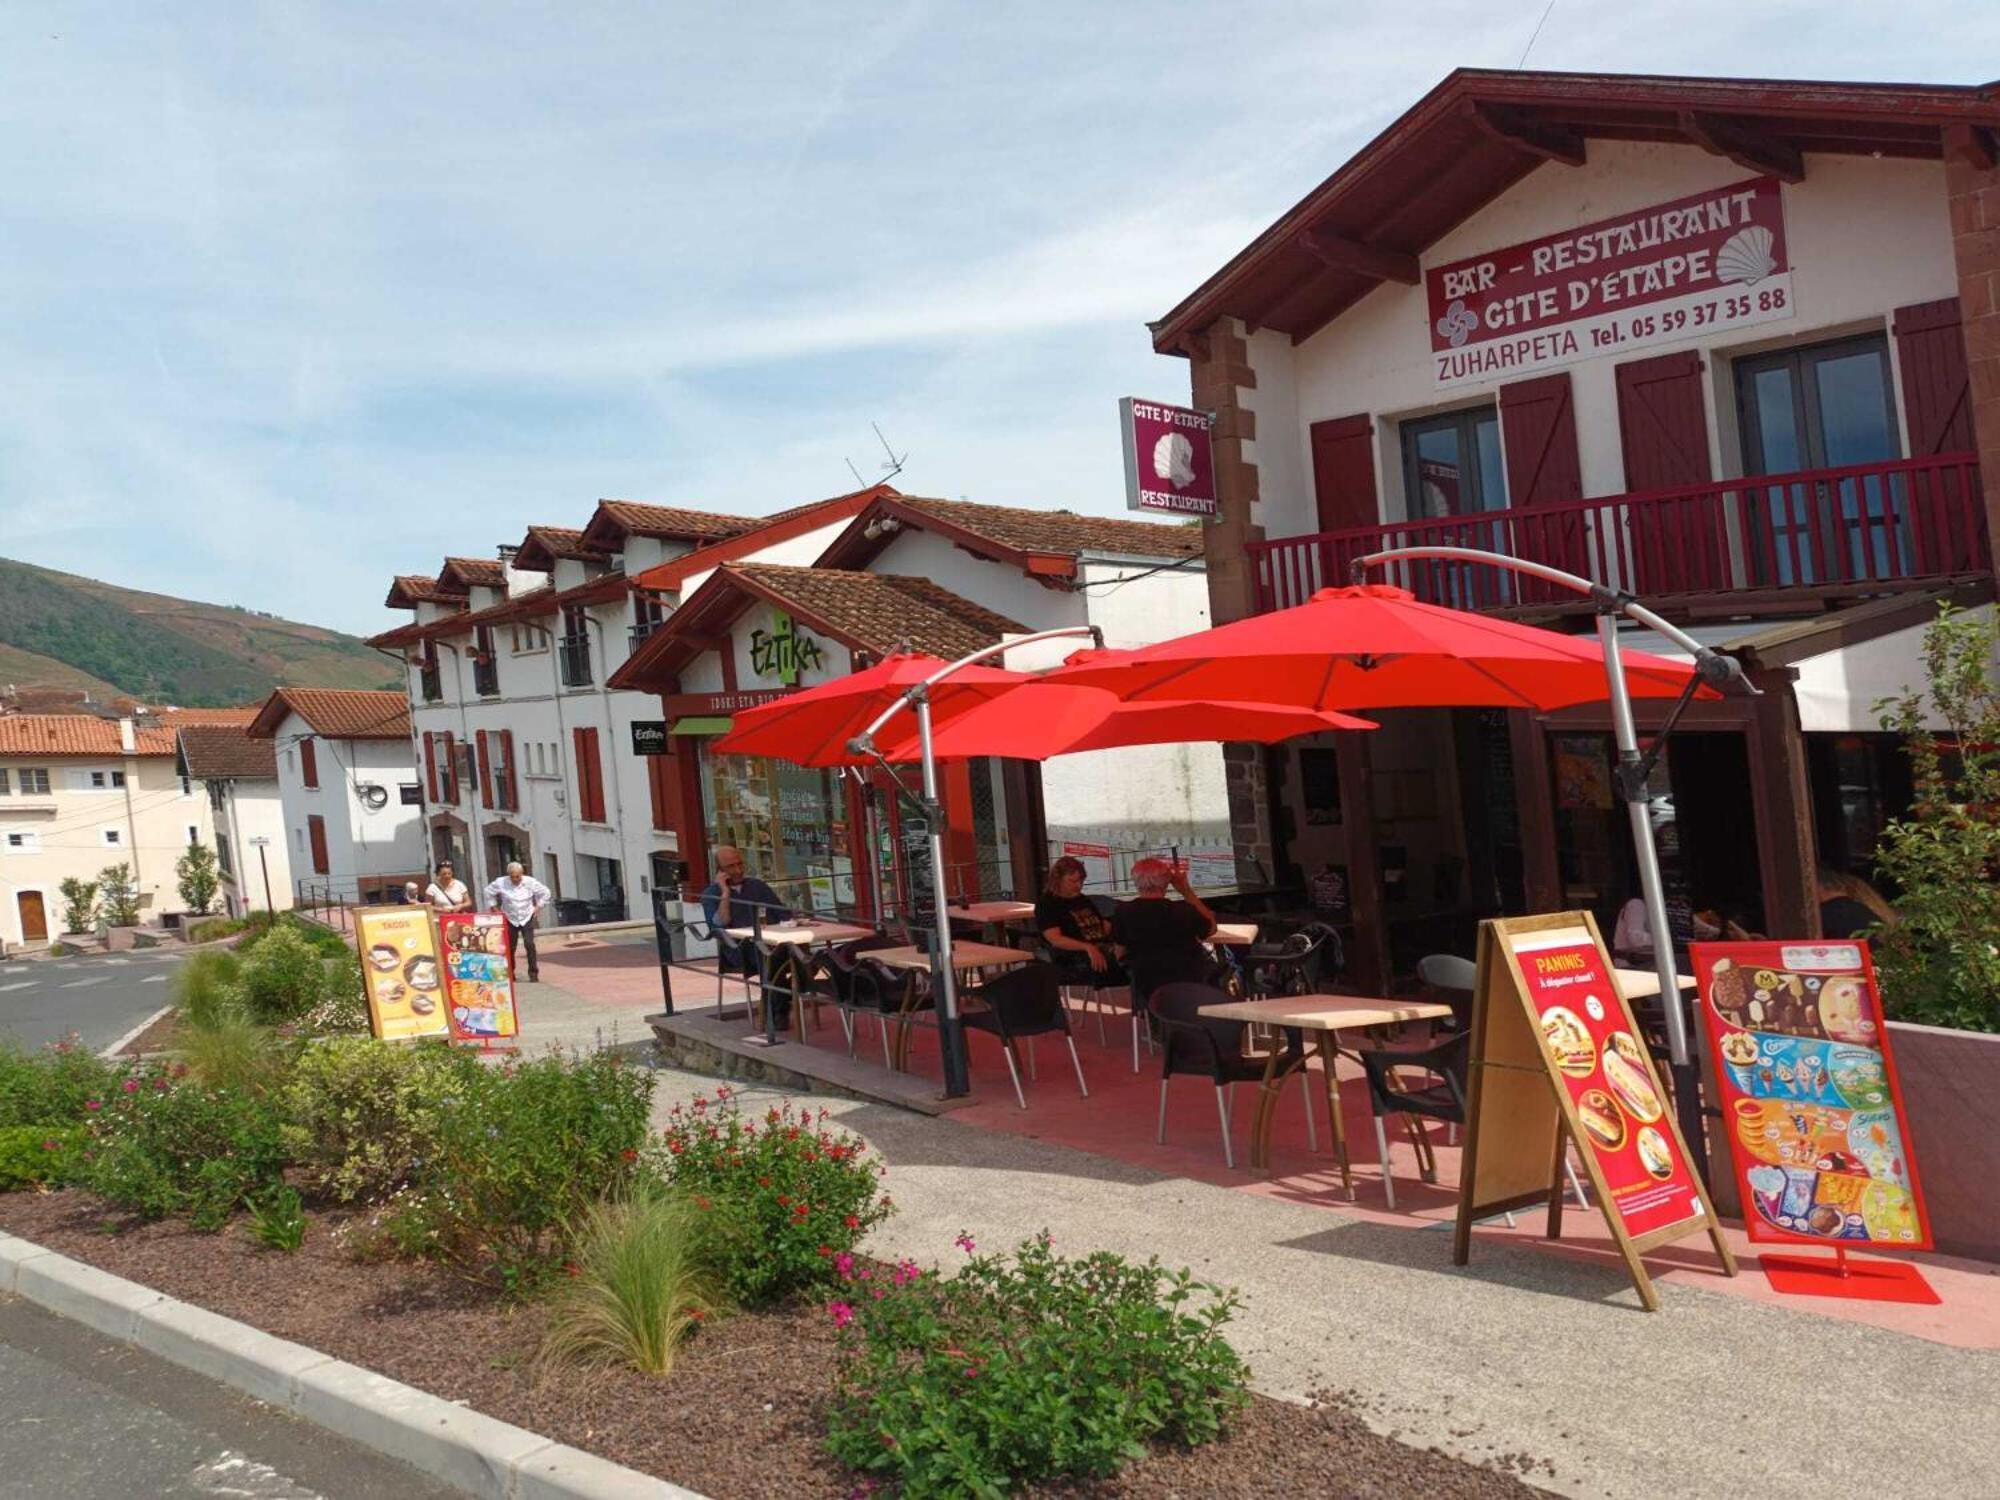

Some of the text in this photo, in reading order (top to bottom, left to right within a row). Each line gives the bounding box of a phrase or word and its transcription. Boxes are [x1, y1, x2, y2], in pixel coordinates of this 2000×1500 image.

[1443, 262, 1497, 300] BAR
[1533, 191, 1756, 276] RESTAURANT
[1568, 248, 1712, 312] D'ÉTAPE
[1438, 288, 1787, 382] ZUHARPETA Tel. 05 59 37 35 88
[1141, 490, 1214, 512] RESTAURANT
[1535, 952, 1585, 974] PANINIS
